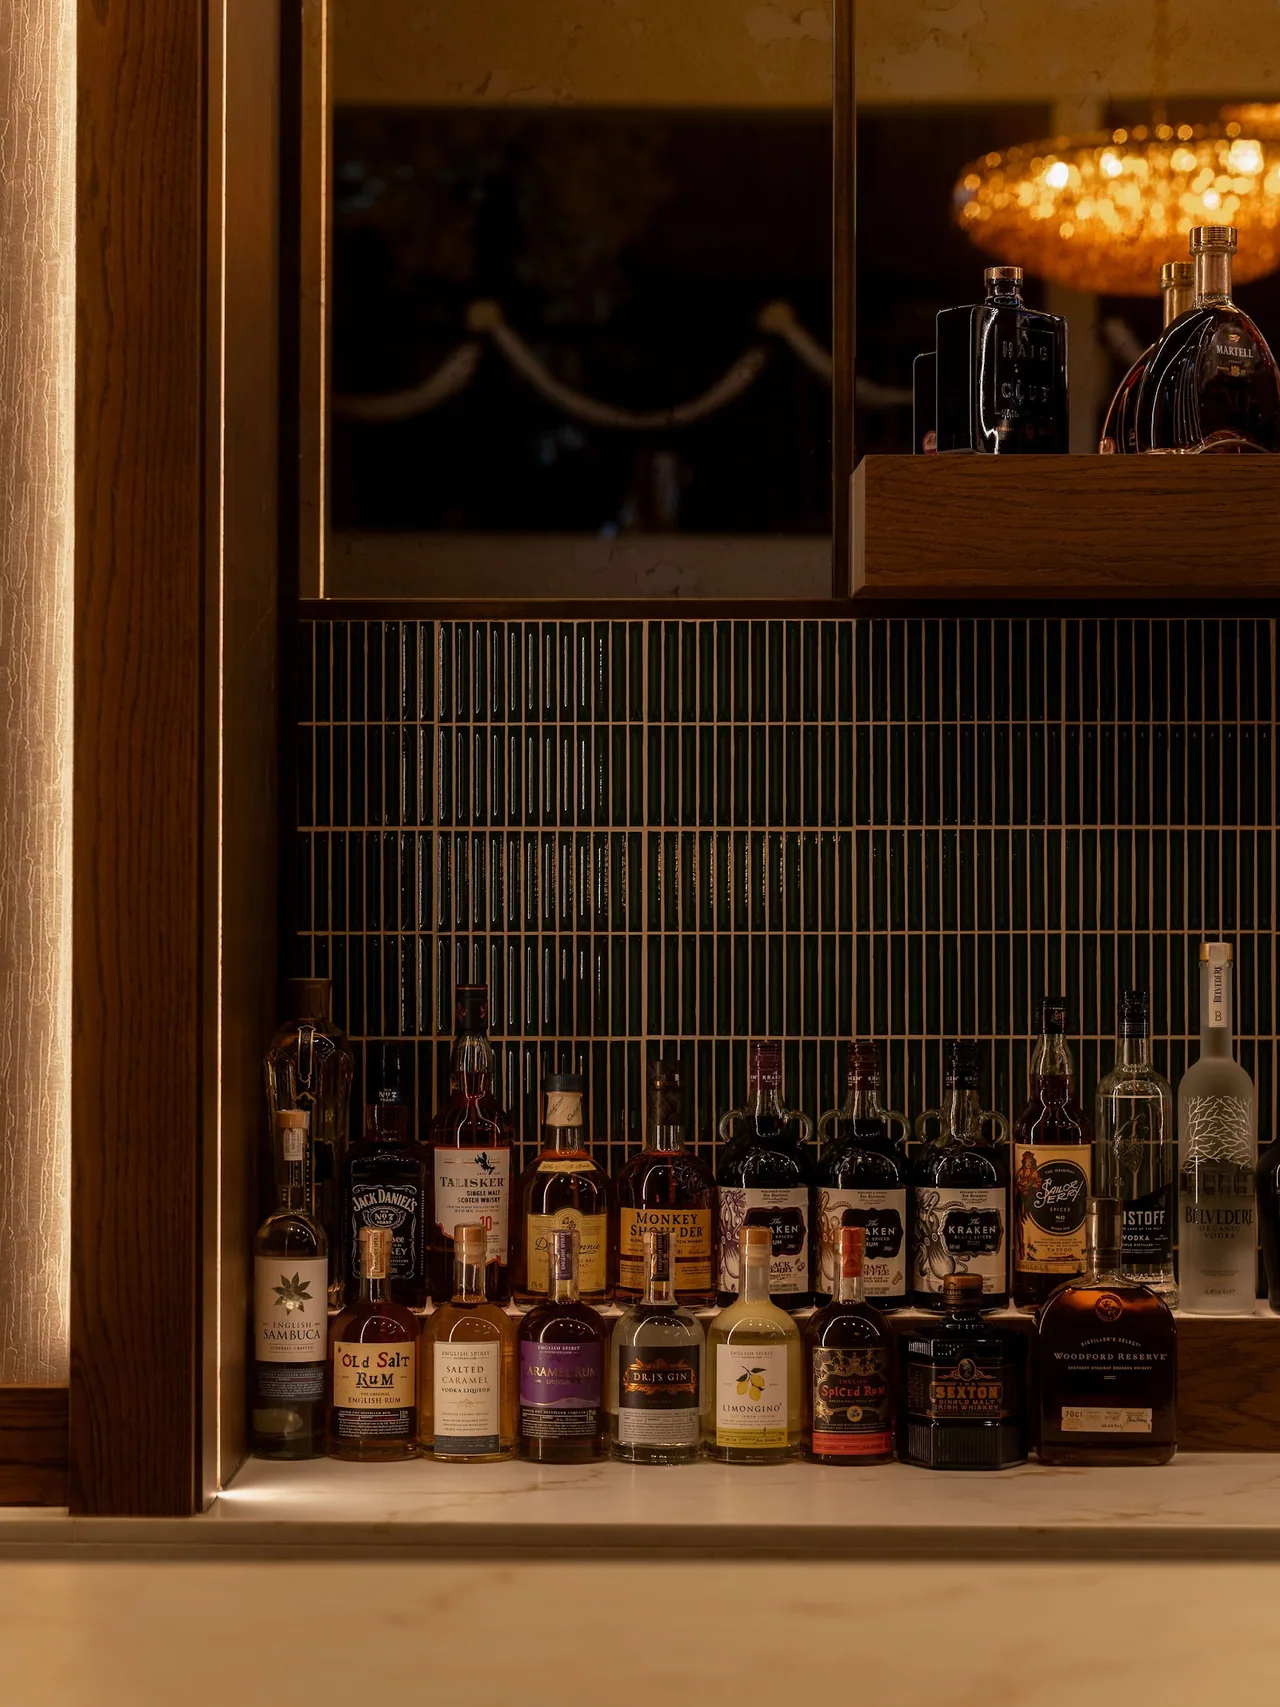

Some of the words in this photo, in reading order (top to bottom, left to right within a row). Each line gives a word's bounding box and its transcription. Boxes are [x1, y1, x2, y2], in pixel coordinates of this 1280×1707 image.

[1216, 344, 1254, 358] MARTELL
[440, 1176, 505, 1188] TALISKER
[352, 1192, 377, 1212] JACK
[636, 1211, 698, 1225] MONKEY
[1184, 1205, 1254, 1226] BELVEDERE
[948, 1225, 996, 1235] KRAKEN
[1122, 1234, 1150, 1242] VODKA
[272, 1321, 312, 1329] ENGLISH
[263, 1329, 321, 1340] SAMBUCA
[1053, 1352, 1115, 1361] WOODFORD
[1117, 1352, 1168, 1361] RESERVE
[446, 1365, 484, 1374] SALTED
[441, 1376, 489, 1384] CARAMEL
[667, 1373, 688, 1381] GIN
[935, 1386, 1000, 1399] SEXTON
[348, 1396, 382, 1404] ENGLISH
[384, 1396, 402, 1404] RUM
[722, 1404, 780, 1413] LIMONGINO
[1065, 1410, 1082, 1418] 70cl
